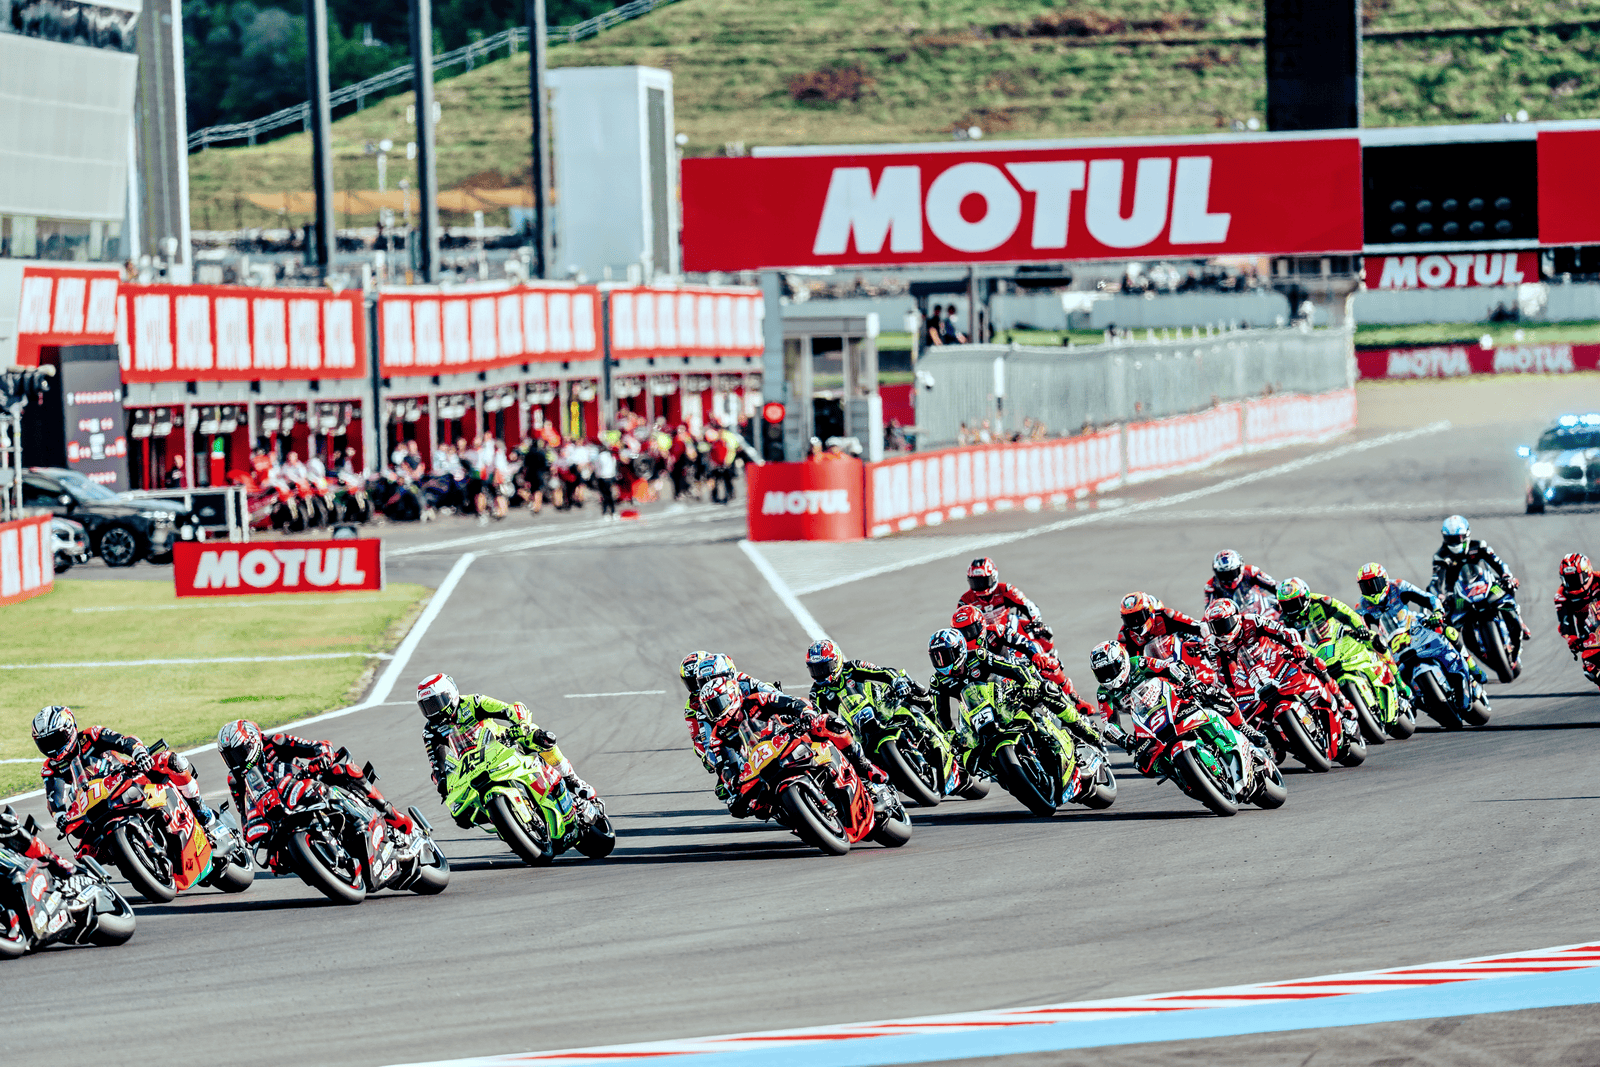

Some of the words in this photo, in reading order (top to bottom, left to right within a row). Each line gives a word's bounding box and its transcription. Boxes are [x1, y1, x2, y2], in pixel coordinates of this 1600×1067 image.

[813, 156, 1231, 254] MOTUL
[1379, 253, 1524, 287] MOTUL
[1387, 348, 1470, 375] MOTUL
[1494, 345, 1574, 373] MOTUL
[761, 489, 851, 515] MOTUL
[193, 547, 365, 588] MOTUL
[1391, 632, 1412, 655] 54
[1276, 662, 1290, 681] Lenovo
[459, 747, 485, 779] 49
[751, 743, 774, 770] 23
[79, 782, 101, 813] 37
